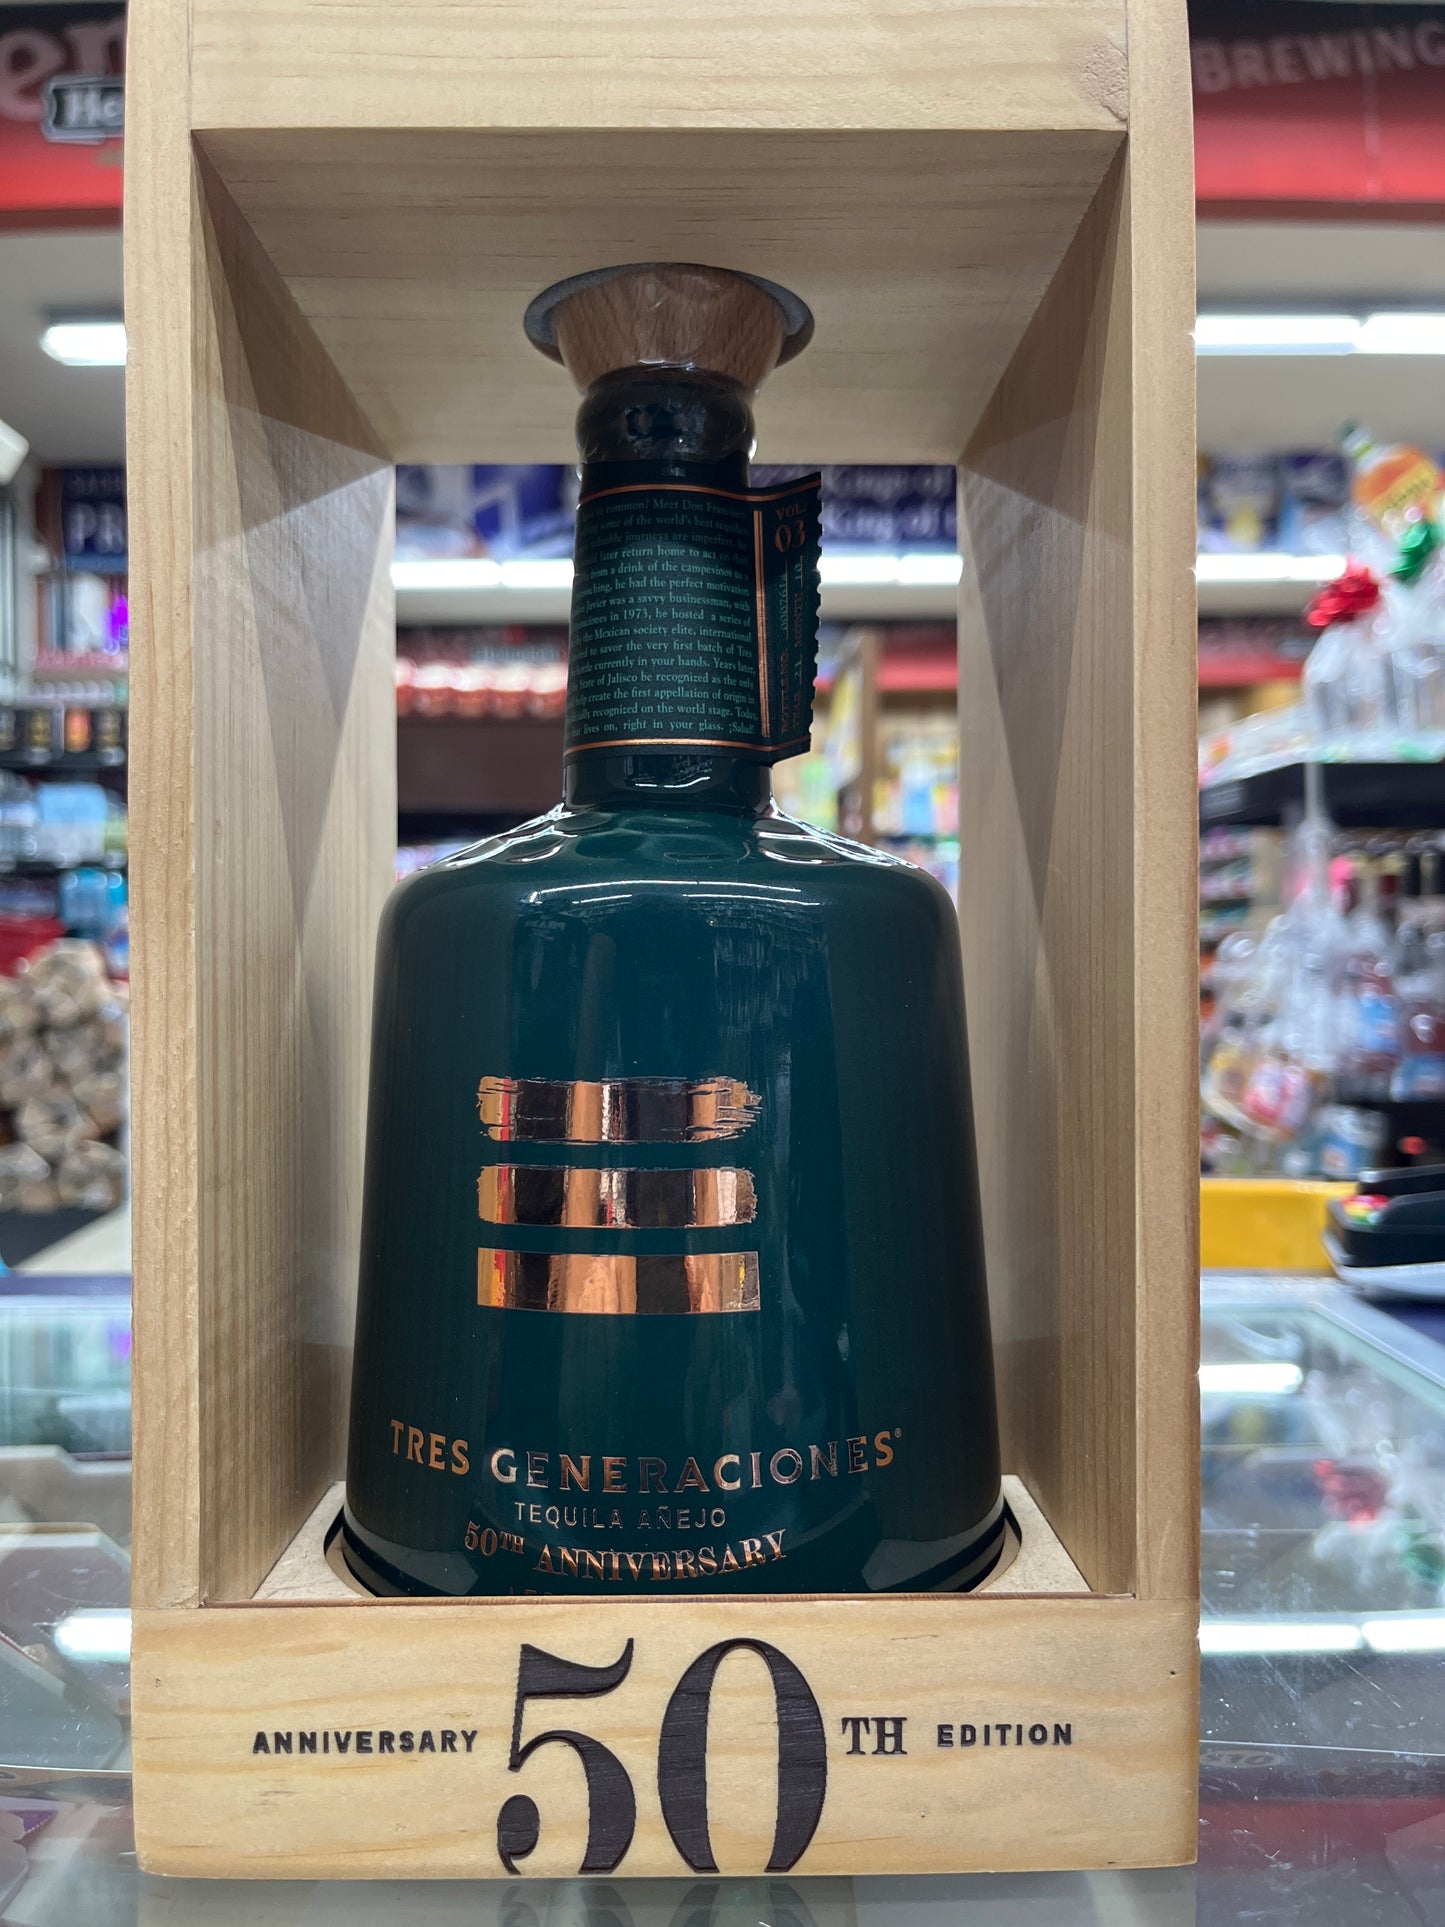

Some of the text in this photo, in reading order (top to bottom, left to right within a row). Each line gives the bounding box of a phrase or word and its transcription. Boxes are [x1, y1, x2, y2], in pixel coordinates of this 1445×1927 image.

[653, 498, 678, 510] Meet
[682, 500, 703, 511] Don
[624, 514, 634, 526] of
[641, 514, 652, 525] the
[655, 514, 692, 526] world's
[694, 514, 713, 528] best
[625, 531, 668, 545] journeys
[673, 533, 687, 541] are
[775, 521, 806, 552] 03
[621, 546, 654, 558] return
[658, 544, 686, 556] home
[689, 547, 700, 557] to
[702, 550, 717, 560] act
[617, 561, 644, 574] drink
[647, 560, 658, 572] of
[661, 560, 678, 572] the
[681, 563, 732, 577] campesinos
[615, 576, 750, 597] he had the perfect motivation
[609, 597, 626, 606] was
[628, 596, 634, 604] a
[637, 594, 665, 606] savvy
[669, 592, 732, 609] businessman,
[734, 600, 750, 612] with
[610, 611, 619, 622] in
[623, 608, 652, 621] 1973,
[655, 607, 668, 619] he
[671, 608, 704, 620] hosted
[710, 613, 717, 621] a
[719, 613, 740, 627] series
[743, 616, 751, 628] of
[594, 626, 630, 639] Mexican
[632, 624, 668, 638] society
[671, 623, 697, 636] elite,
[699, 625, 752, 643] international
[590, 647, 598, 657] to
[600, 644, 622, 654] savor
[626, 640, 643, 651] the
[646, 642, 669, 654] very
[673, 640, 693, 651] first
[697, 640, 723, 653] batch
[726, 643, 735, 655] of
[736, 645, 753, 658] Tres
[594, 656, 634, 671] currently
[637, 655, 648, 667] in
[651, 657, 675, 669] your
[678, 656, 711, 668] hands.
[712, 658, 736, 671] Years
[596, 673, 607, 686] of
[607, 672, 638, 687] Jalisco
[641, 670, 652, 682] be
[656, 672, 709, 685] recognized
[711, 675, 721, 684] as
[723, 674, 737, 685] the
[738, 678, 754, 691] only
[588, 691, 611, 703] create
[613, 688, 629, 699] the
[631, 686, 652, 698] first
[654, 687, 709, 701] appellation
[712, 689, 722, 700] of
[723, 693, 747, 706] origin
[593, 702, 638, 718] recognized
[640, 704, 654, 713] on
[657, 702, 673, 713] the
[677, 702, 705, 714] world
[708, 705, 734, 719] stage.
[584, 721, 600, 735] lives
[603, 723, 618, 733] on,
[623, 719, 647, 732] right
[653, 719, 663, 730] in
[669, 720, 694, 732] your
[699, 720, 724, 733] glass.
[390, 1419, 470, 1476] TRES
[514, 1501, 727, 1531] TEQUILA AÑEJO
[533, 1528, 788, 1583] ANNIVERSARY
[251, 1729, 478, 1756] ANNIVERSARY
[935, 1722, 1074, 1749] EDITION
